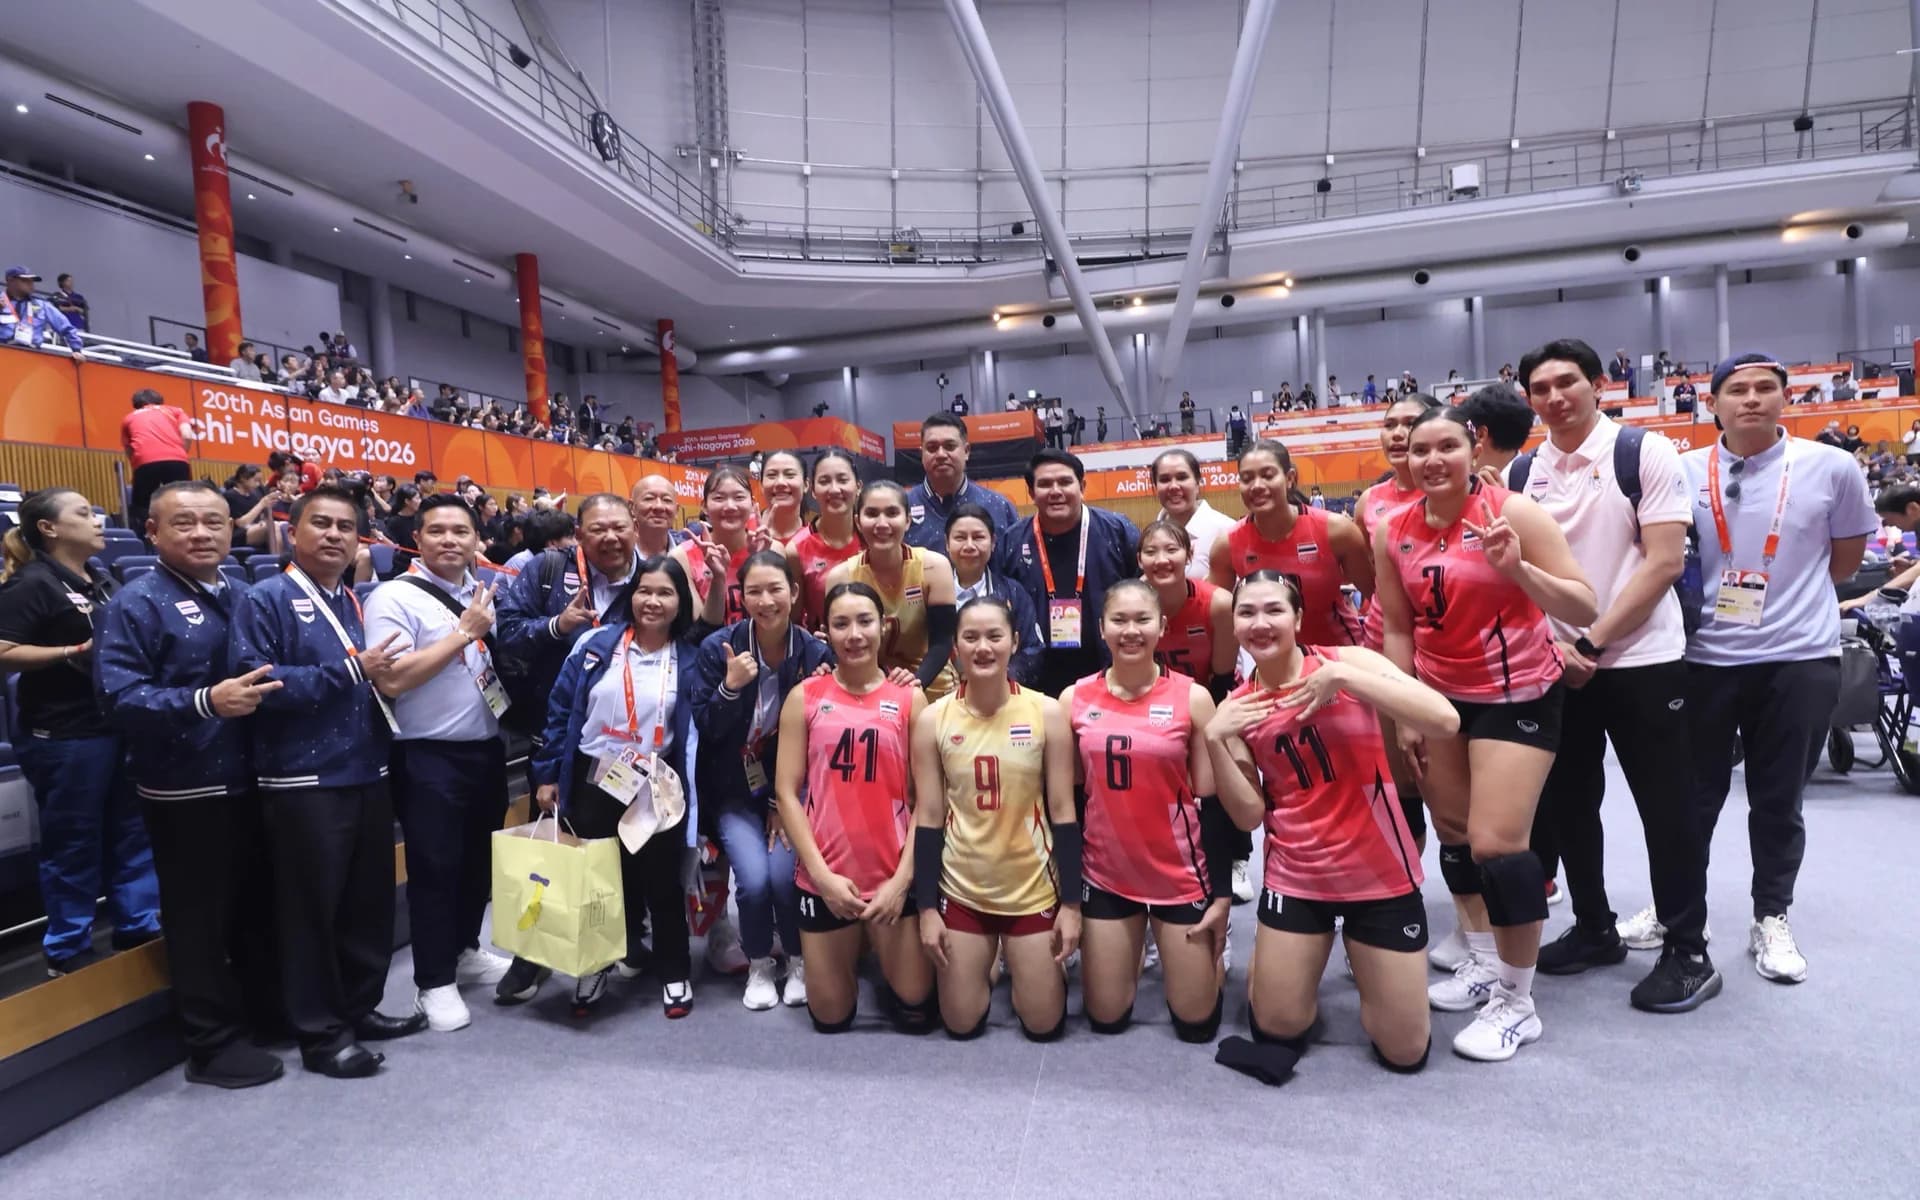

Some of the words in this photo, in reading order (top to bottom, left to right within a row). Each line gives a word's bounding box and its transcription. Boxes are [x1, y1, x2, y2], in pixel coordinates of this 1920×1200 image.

[202, 389, 254, 415] 20th
[260, 399, 314, 424] Asan
[318, 409, 380, 433] Games
[190, 412, 355, 464] chi-Nagoya
[360, 437, 416, 465] 2026
[733, 437, 756, 448] 2026
[1422, 564, 1448, 632] 3
[830, 727, 879, 783] 41
[1106, 734, 1133, 791] 6
[1275, 724, 1337, 790] 11
[974, 755, 1001, 811] 9
[800, 895, 816, 918] 41
[1266, 889, 1284, 914] 11
